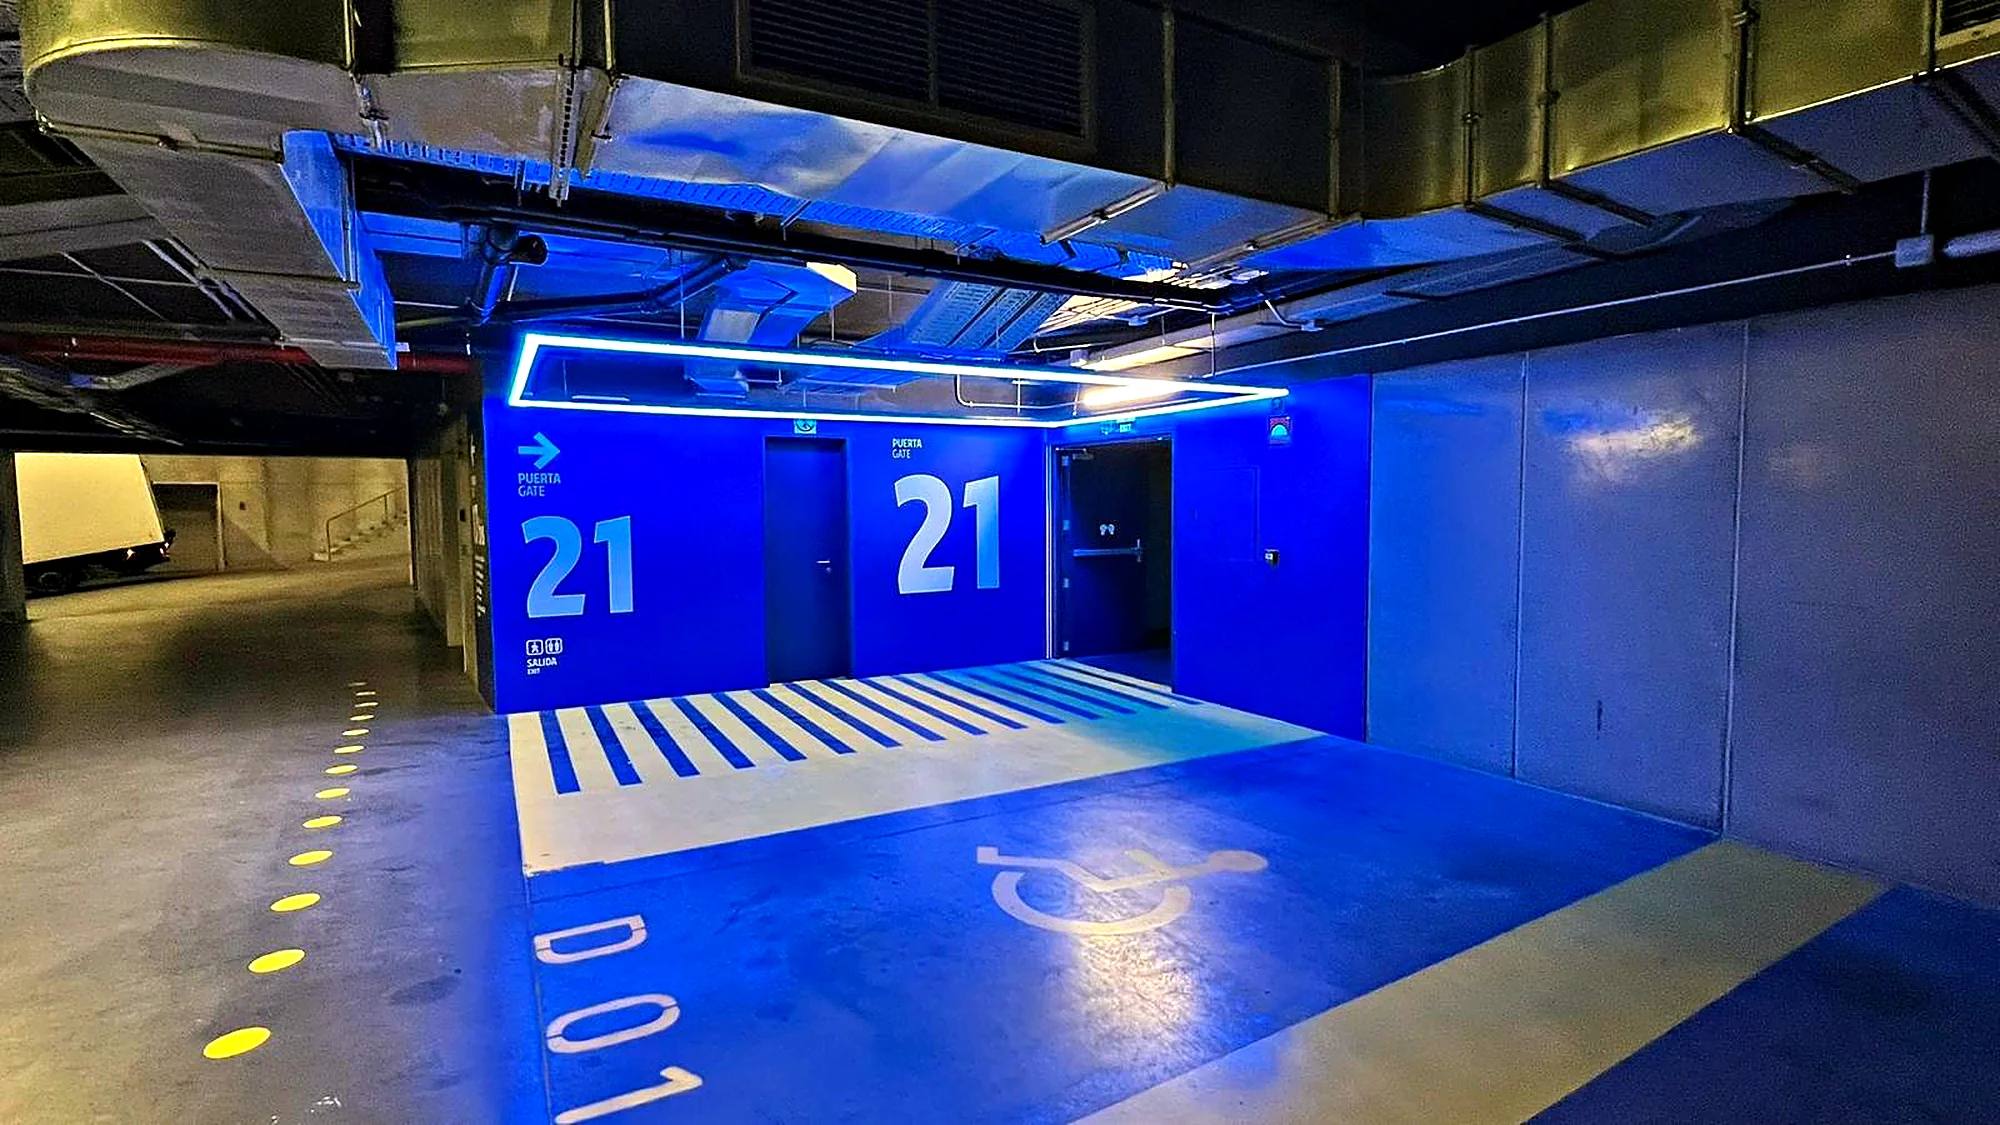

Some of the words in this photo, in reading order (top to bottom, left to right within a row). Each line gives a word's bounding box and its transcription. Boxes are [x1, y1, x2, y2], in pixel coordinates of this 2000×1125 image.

[892, 438, 922, 448] PUERTA
[892, 449, 911, 459] GATE
[518, 472, 561, 484] PUERTA
[518, 485, 545, 497] GATE
[893, 473, 999, 594] 21
[521, 515, 633, 618] 21
[526, 657, 557, 668] SALIDA
